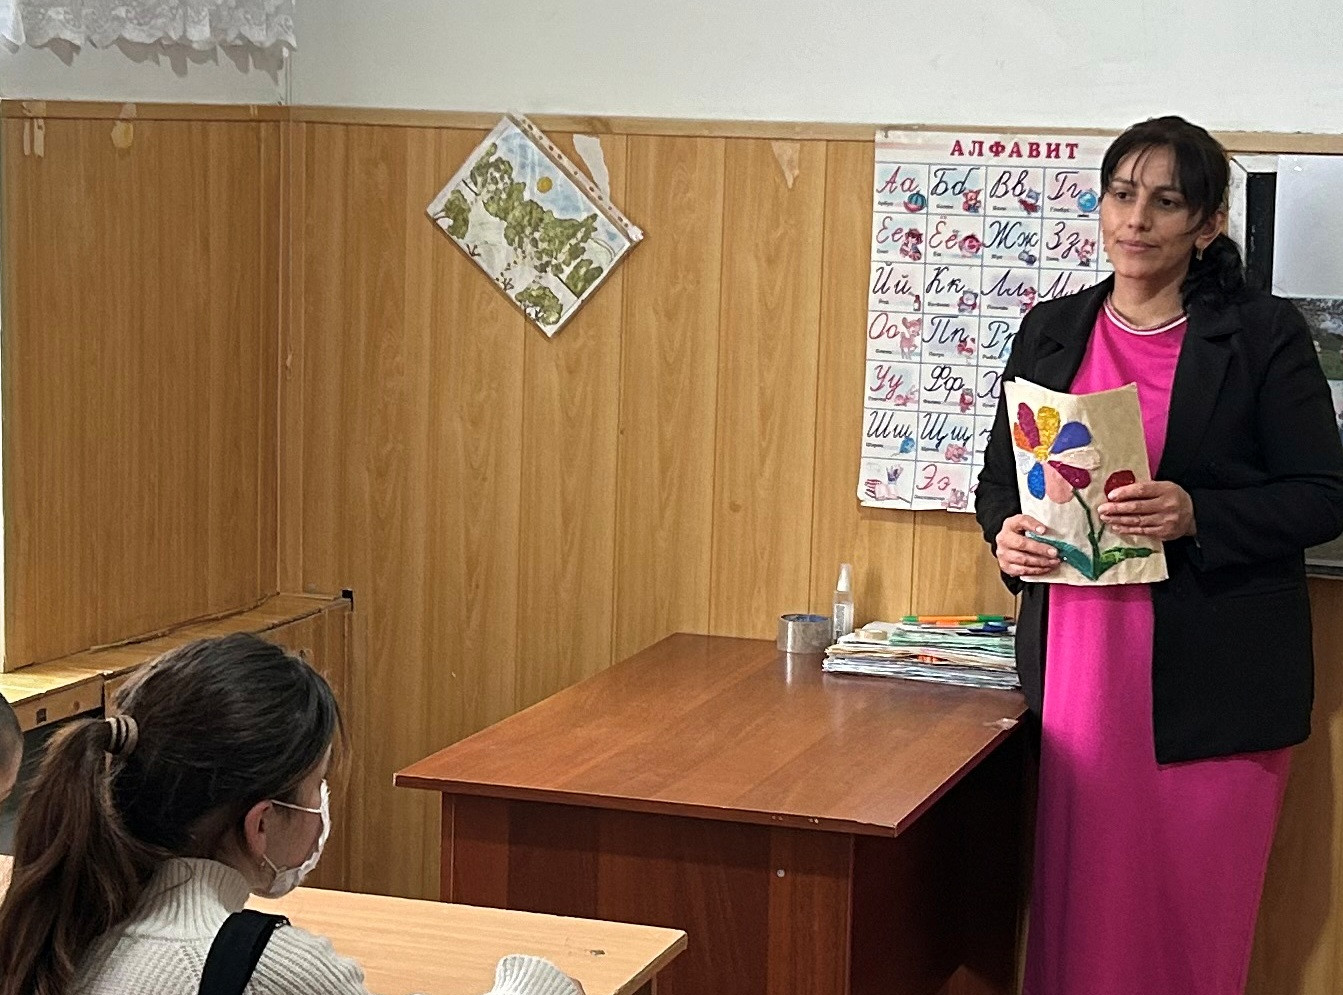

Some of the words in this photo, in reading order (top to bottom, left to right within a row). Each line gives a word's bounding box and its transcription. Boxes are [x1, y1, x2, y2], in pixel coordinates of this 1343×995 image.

[949, 139, 1079, 159] АЛФАВИТ
[876, 166, 919, 194] Аа
[930, 167, 980, 196] Бб
[989, 169, 1026, 198] Вв
[1047, 171, 1082, 200] Гг
[876, 216, 903, 244] Ее
[984, 220, 1040, 249] Жж
[1046, 221, 1080, 259] Зз
[925, 266, 965, 294] Кк
[868, 312, 900, 340] Оо
[921, 315, 969, 344] Пп
[869, 364, 904, 400] Уу
[923, 364, 965, 403] Фф
[866, 410, 913, 439] Шш
[920, 412, 974, 448] Щщ
[916, 463, 951, 491] Ээ
